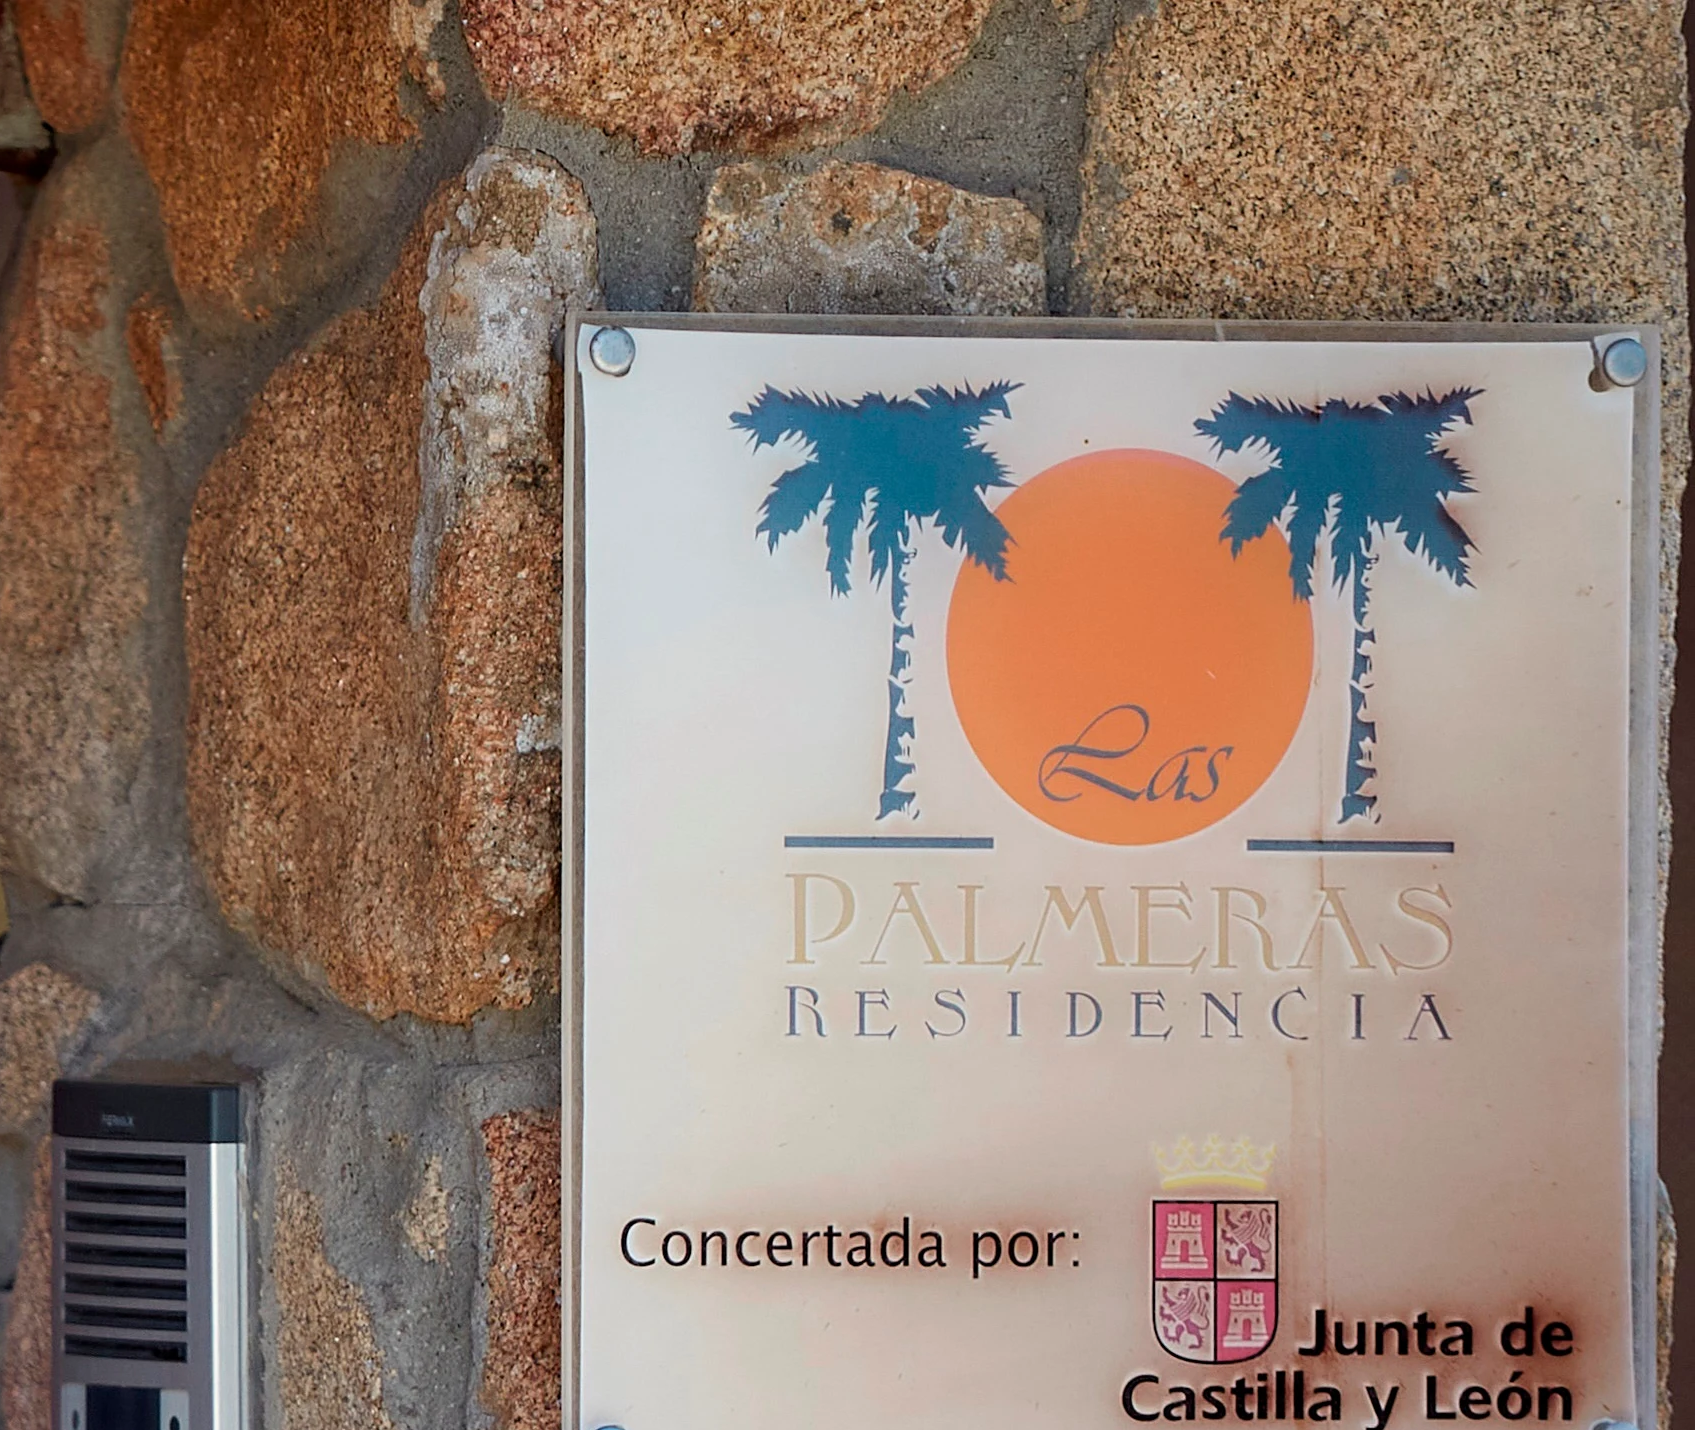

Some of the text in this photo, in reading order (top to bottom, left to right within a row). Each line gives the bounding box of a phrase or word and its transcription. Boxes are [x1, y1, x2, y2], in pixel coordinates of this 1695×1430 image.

[1038, 703, 1232, 803] Las
[783, 872, 1454, 976] PALMERAS
[784, 985, 1453, 1042] RESIDENCIA
[619, 1217, 1082, 1278] Concertada por:
[1297, 1306, 1574, 1358] Junta de
[1121, 1370, 1342, 1422] Castilla
[1426, 1371, 1573, 1420] León
